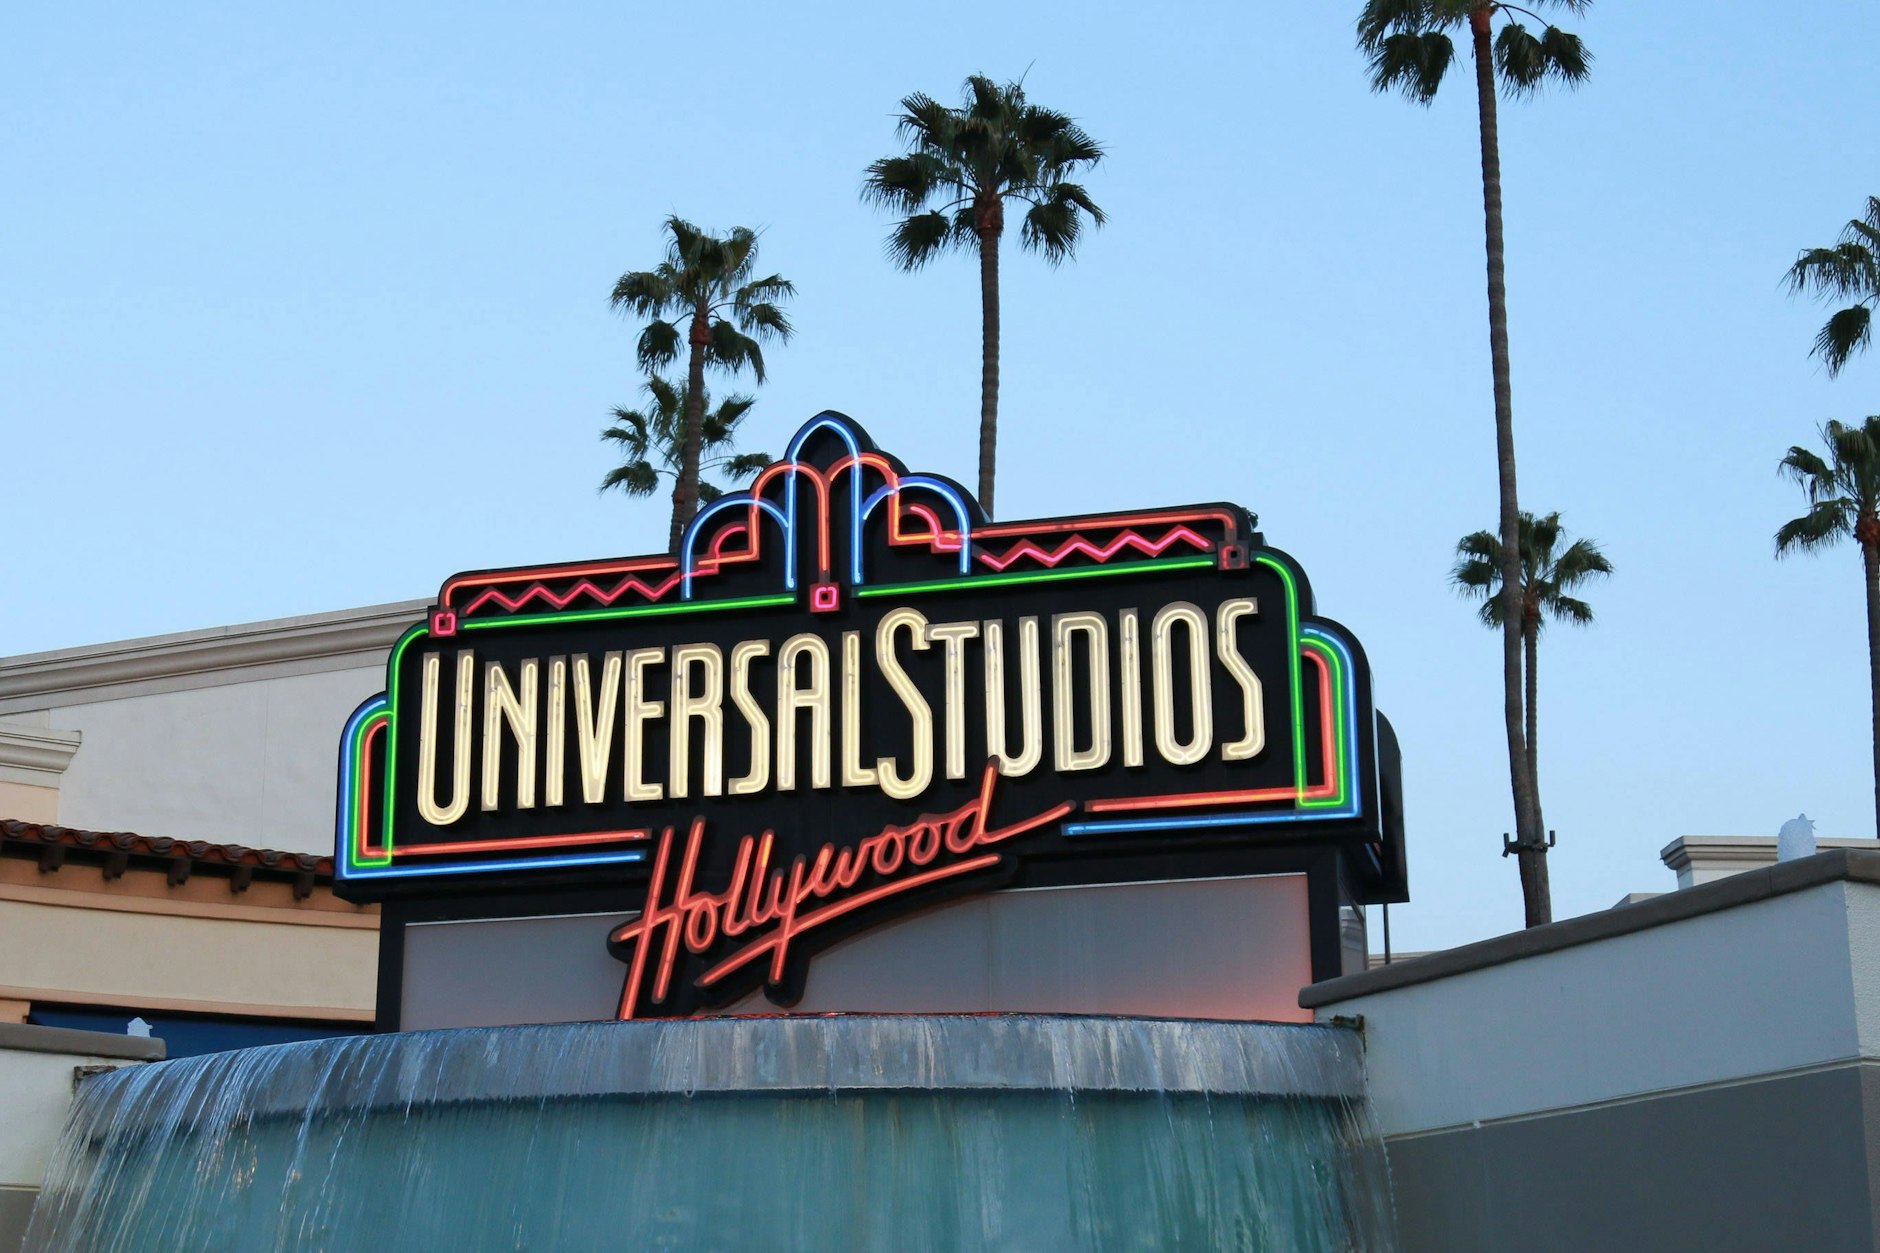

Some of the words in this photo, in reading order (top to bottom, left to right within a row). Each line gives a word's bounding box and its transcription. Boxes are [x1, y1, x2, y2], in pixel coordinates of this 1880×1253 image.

[416, 630, 879, 827] UNIVERSAL
[876, 597, 1265, 800] STUDIOS
[611, 754, 1076, 1020] Hollywood
